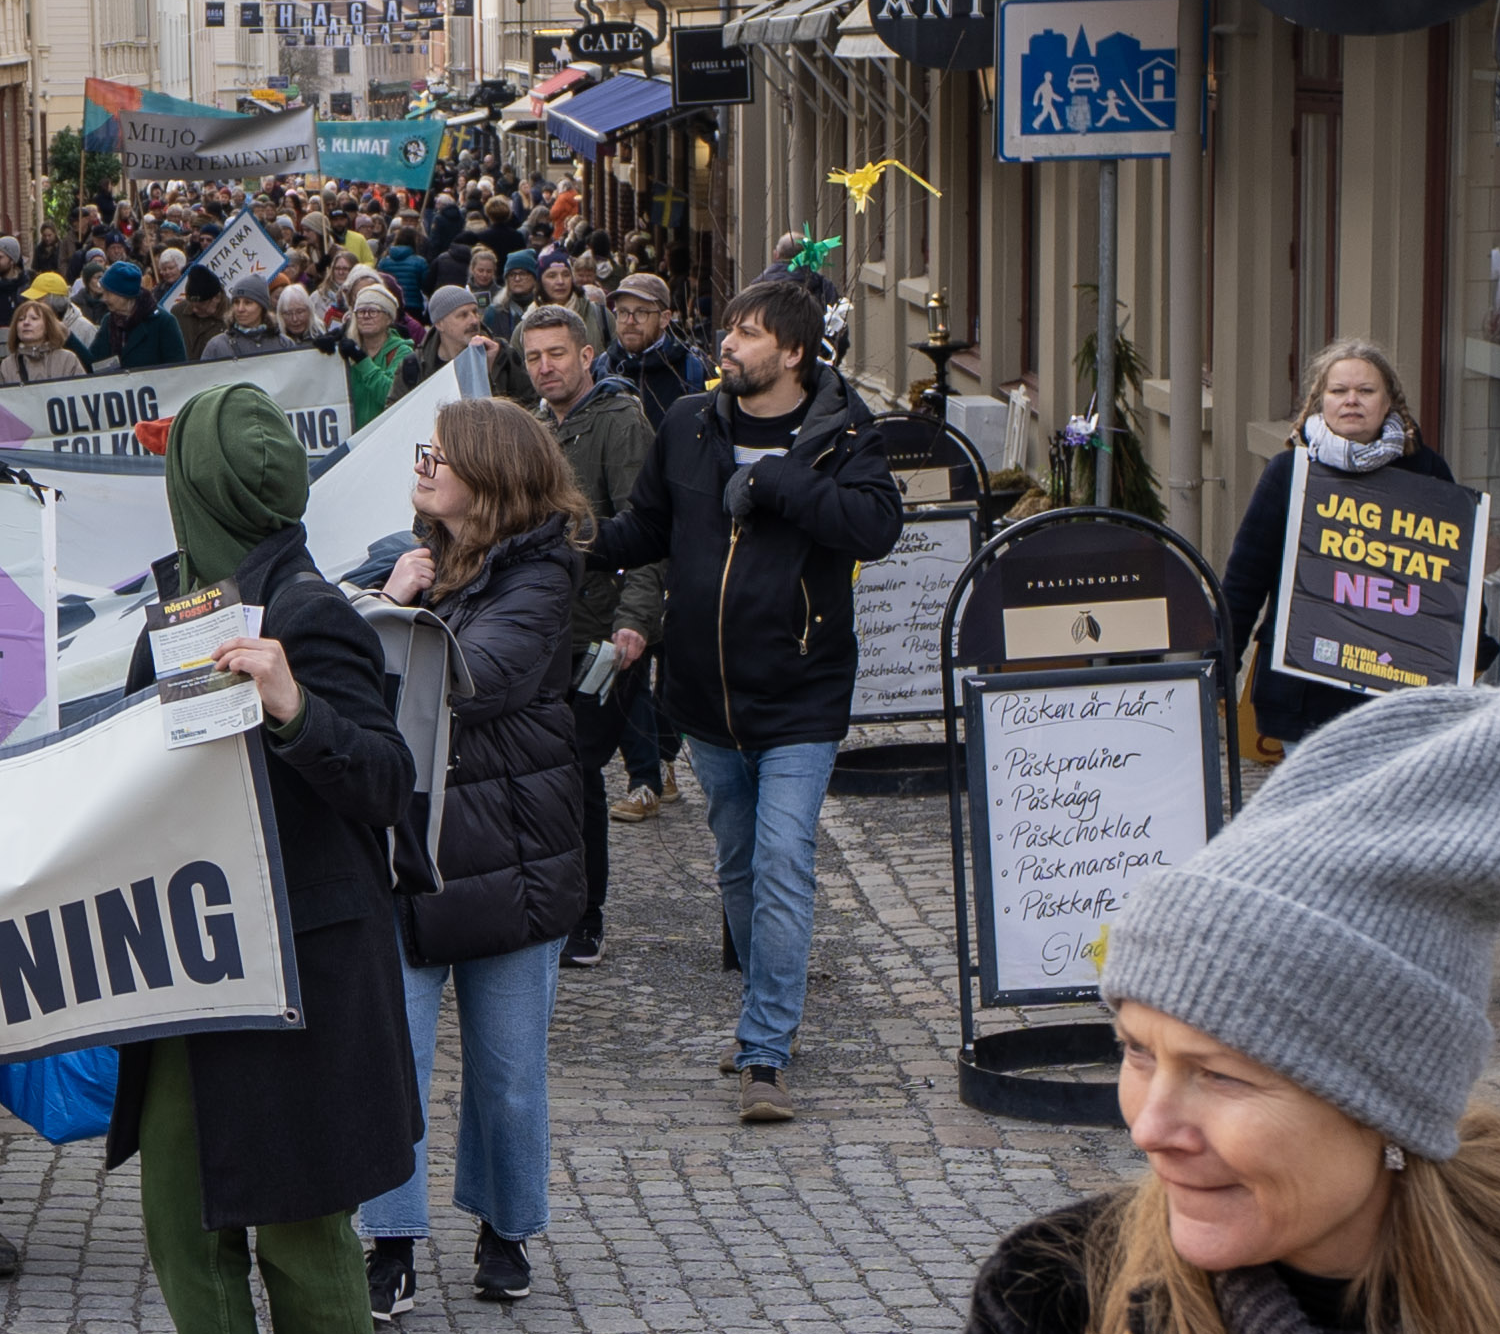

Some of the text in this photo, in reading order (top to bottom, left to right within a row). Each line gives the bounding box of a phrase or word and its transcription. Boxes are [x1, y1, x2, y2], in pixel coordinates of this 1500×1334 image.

[578, 27, 644, 53] CAFÉ
[125, 144, 310, 171] DEPARTEMENTET
[331, 138, 391, 156] KLIMAT
[229, 225, 252, 249] RIKA
[46, 385, 160, 436] OLYDIG
[1316, 494, 1461, 550] JAG HAR
[1319, 527, 1450, 583] RÖSTAT
[1026, 573, 1141, 589] PRALINBODEN
[1333, 570, 1421, 616] NEJ
[164, 588, 223, 615] RÖSTA NEJ TILL
[178, 601, 213, 620] FOSSILT
[1342, 643, 1378, 662] OLYDIG
[1341, 655, 1429, 687] FOLKOMRÖSTNING
[989, 692, 1075, 727] Påsken
[1080, 691, 1111, 718] är
[1004, 747, 1142, 785] Påskpraliner
[1011, 780, 1102, 822] Påskägg
[1010, 814, 1152, 849] Påskchoklad
[1015, 850, 1172, 884] Påskmarsipan
[1019, 888, 1122, 921] Påskkaffe
